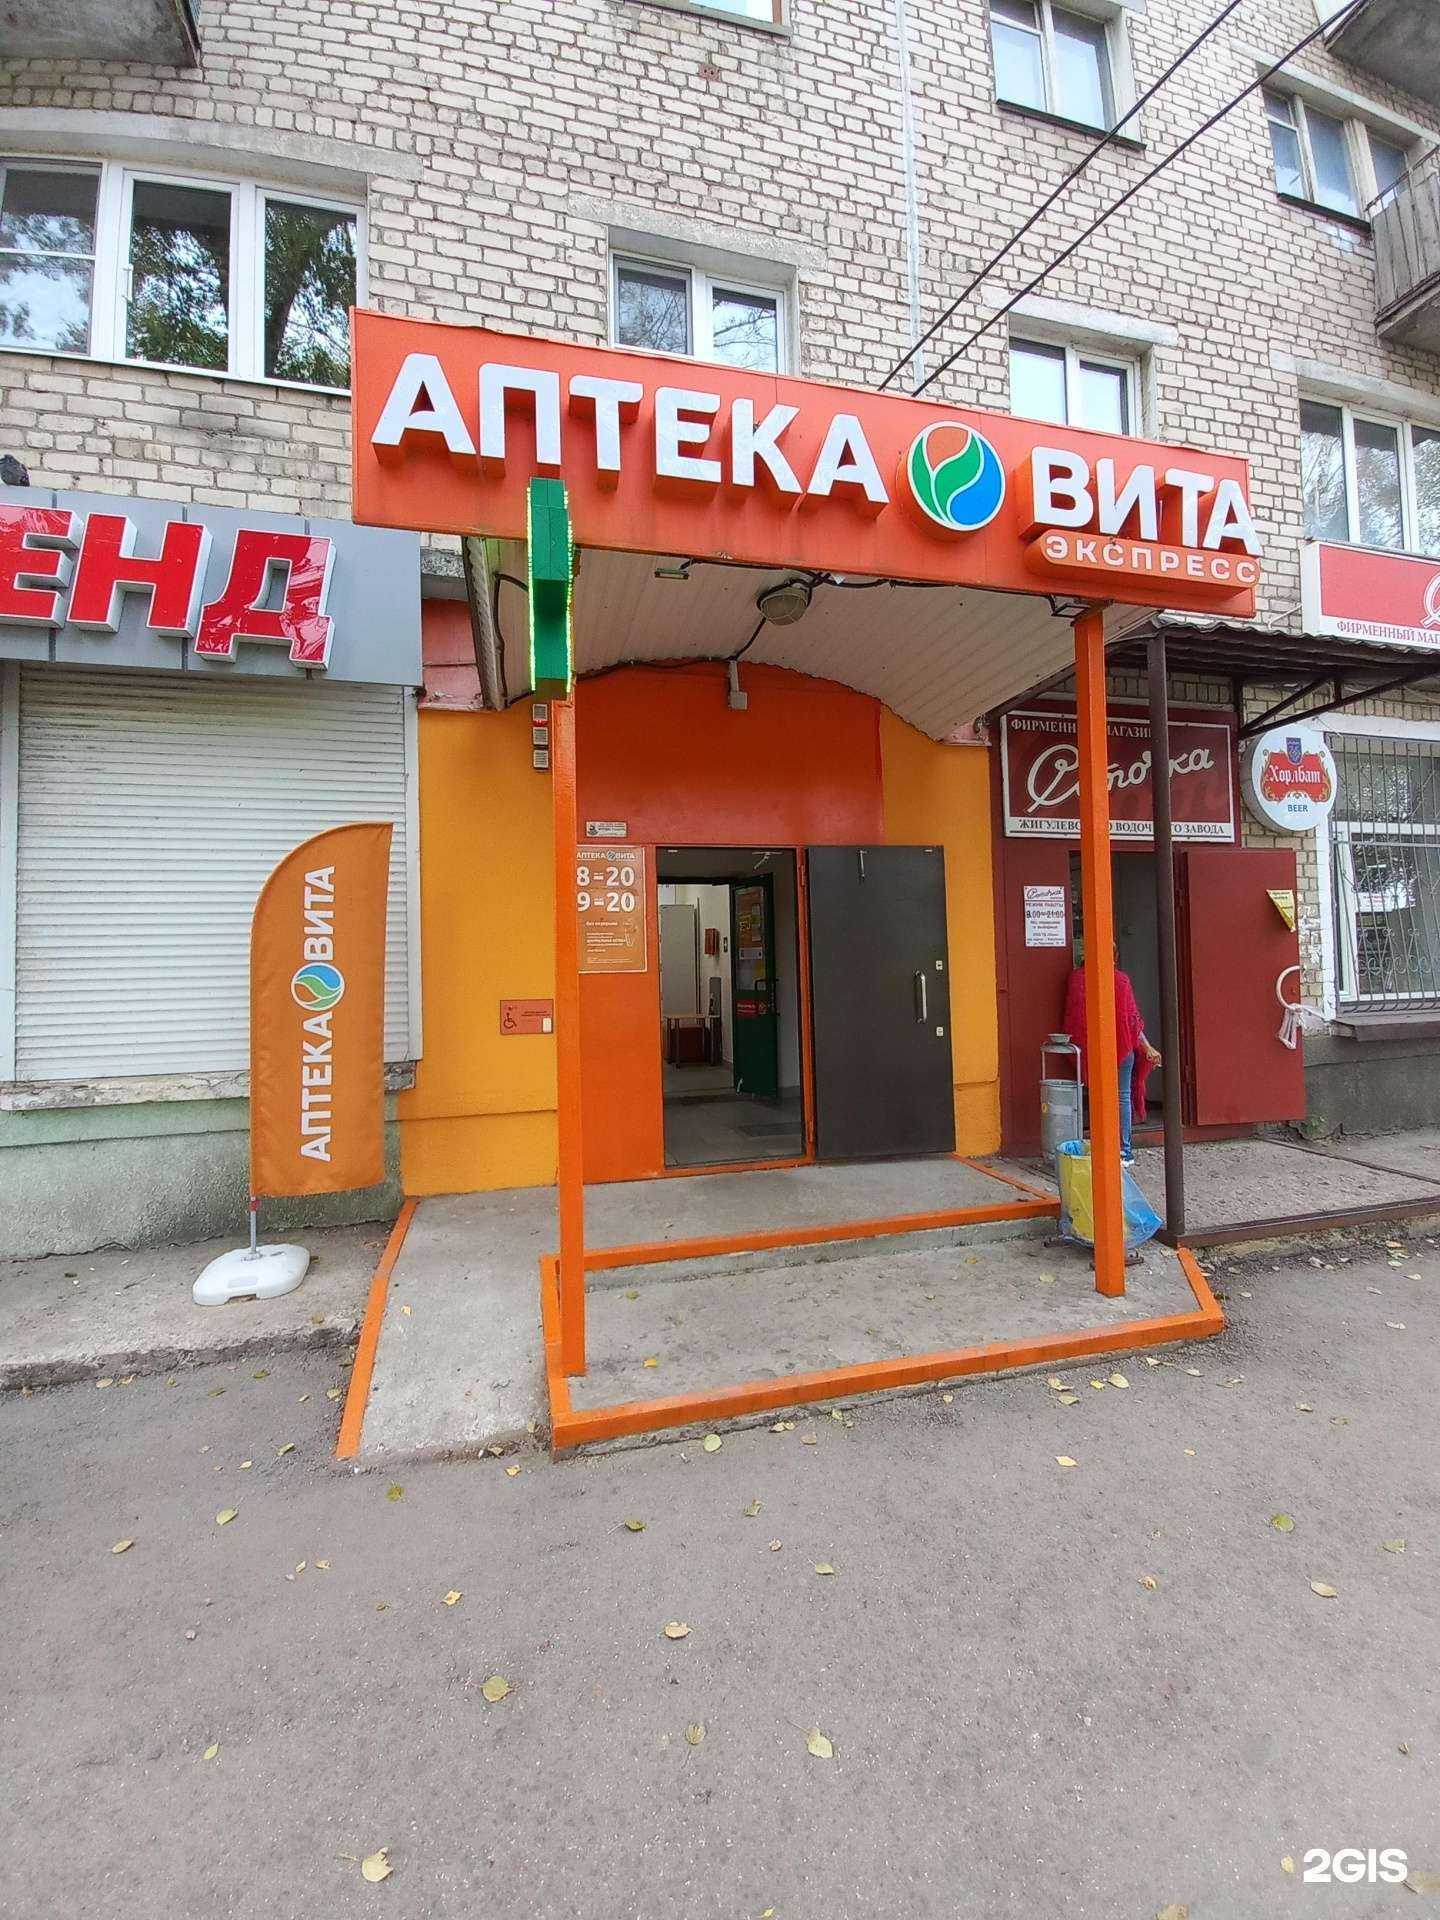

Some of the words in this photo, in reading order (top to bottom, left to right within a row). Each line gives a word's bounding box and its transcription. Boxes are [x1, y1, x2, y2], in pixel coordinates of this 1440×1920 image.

[371, 352, 890, 504] АПТЕКА
[1031, 446, 1263, 557] ВИТА
[1044, 534, 1258, 584] ЭКСПРЕСС
[1336, 620, 1415, 640] ФИРМЕННЫЙ
[1010, 718, 1077, 734] ФИРМЕНН
[1287, 804, 1309, 813] BEER
[1019, 819, 1112, 831] ЖИГУЛЕВС
[1183, 824, 1225, 835] ЗАВОДА
[304, 865, 336, 961] ВИТА
[300, 1011, 333, 1162] АПТЕКА
